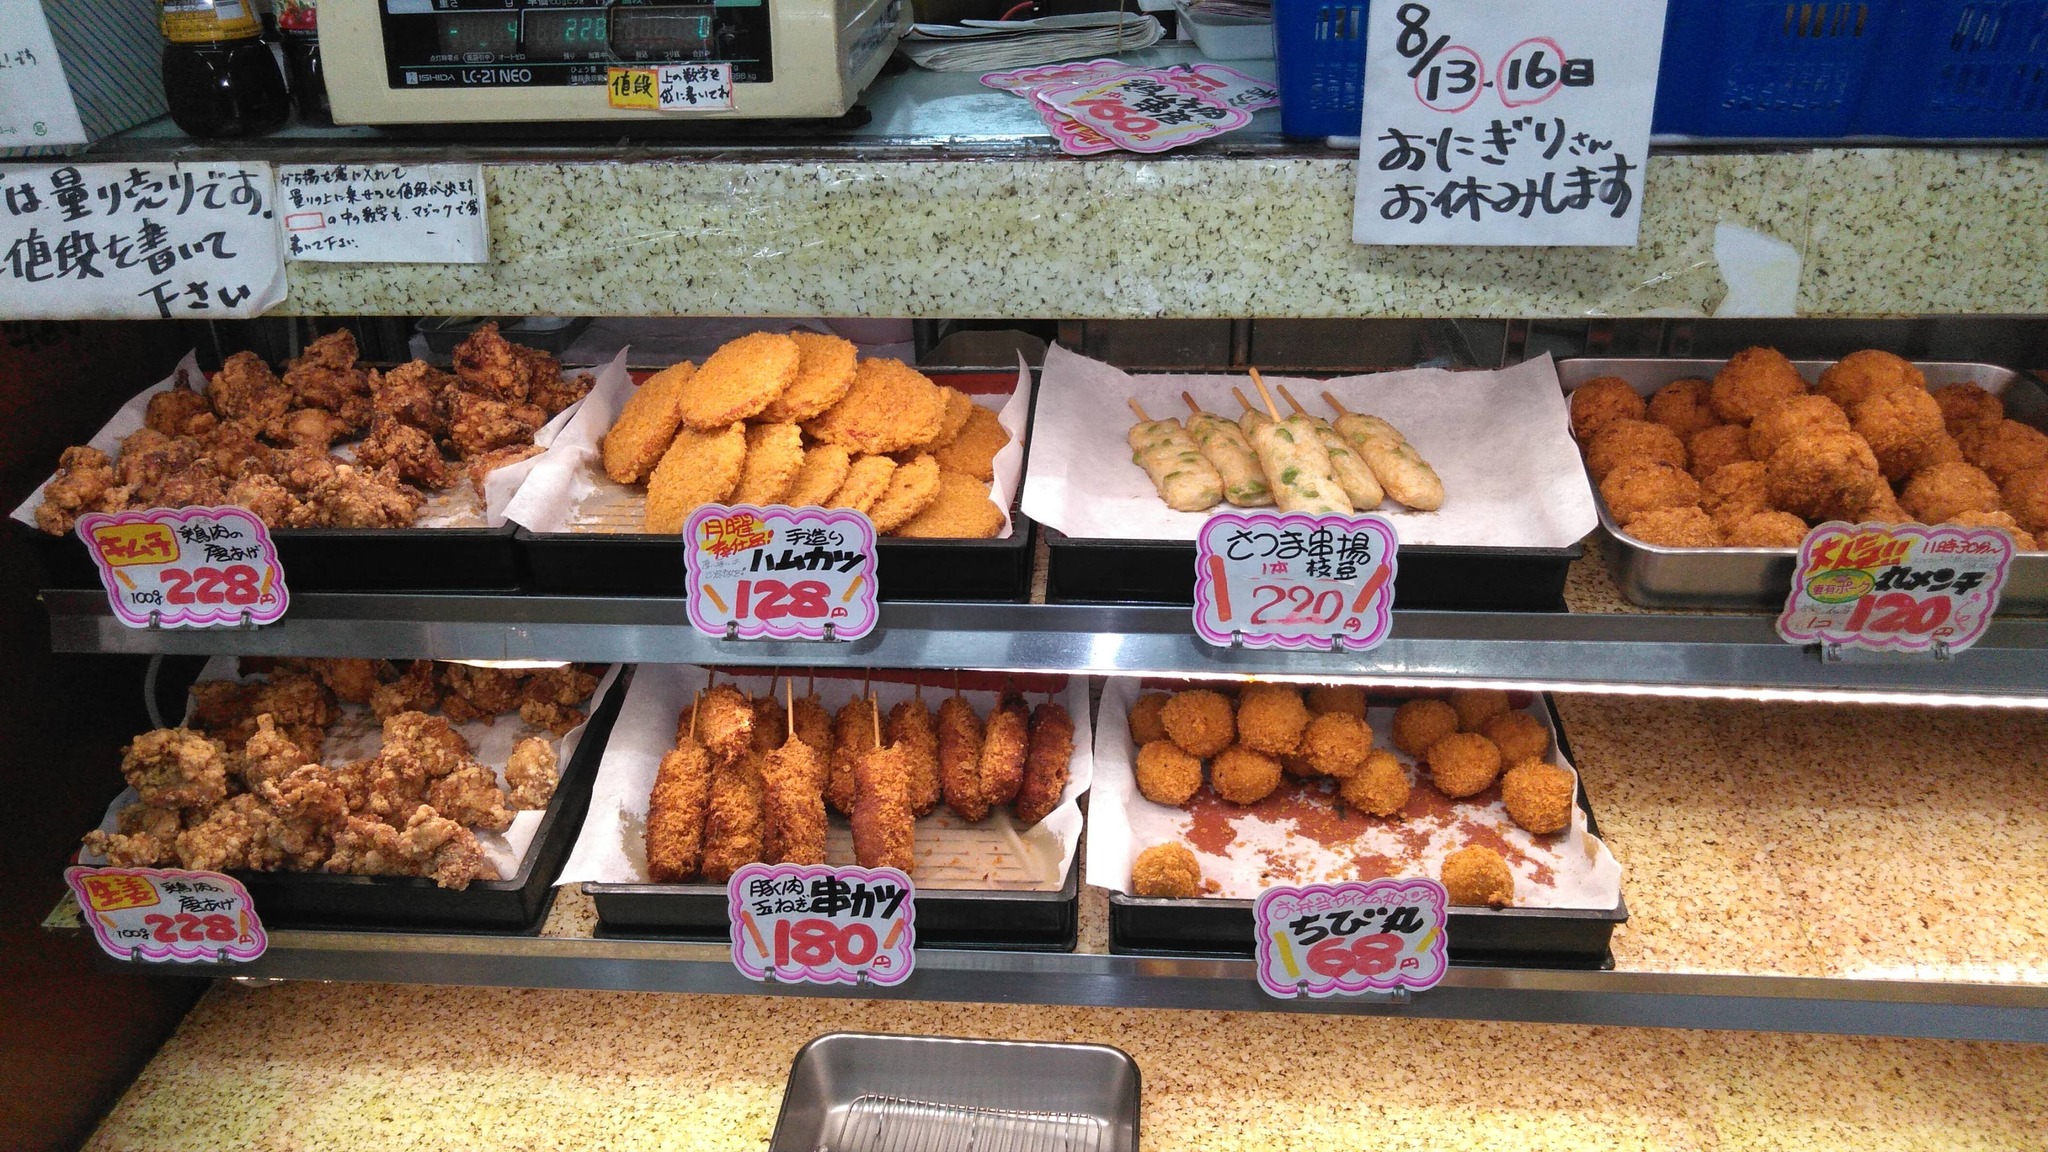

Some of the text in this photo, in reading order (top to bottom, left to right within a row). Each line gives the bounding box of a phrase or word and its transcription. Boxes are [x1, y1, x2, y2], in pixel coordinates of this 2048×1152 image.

[565, 17, 608, 41] 228
[418, 69, 532, 84] ISHIDA LC-21 NEO
[611, 70, 654, 98] 値段
[661, 66, 721, 84] 上の数字を
[1378, 116, 1613, 172] おにぎりさん
[1379, 153, 1637, 224] お休みします
[138, 280, 251, 319] 下さい
[704, 513, 755, 542] 月曜
[785, 528, 845, 546] 手造り
[99, 531, 172, 559] キムチ
[1226, 526, 1372, 566] さつま串揚
[749, 547, 867, 574] ハムカツ
[1261, 561, 1289, 576] 1本
[1305, 558, 1358, 581] 枝豆
[1874, 565, 1986, 596] 丸メンチ
[752, 894, 812, 917] 玉ねぎ
[810, 875, 910, 920] 串カツ
[1288, 906, 1425, 946] ちび丸
